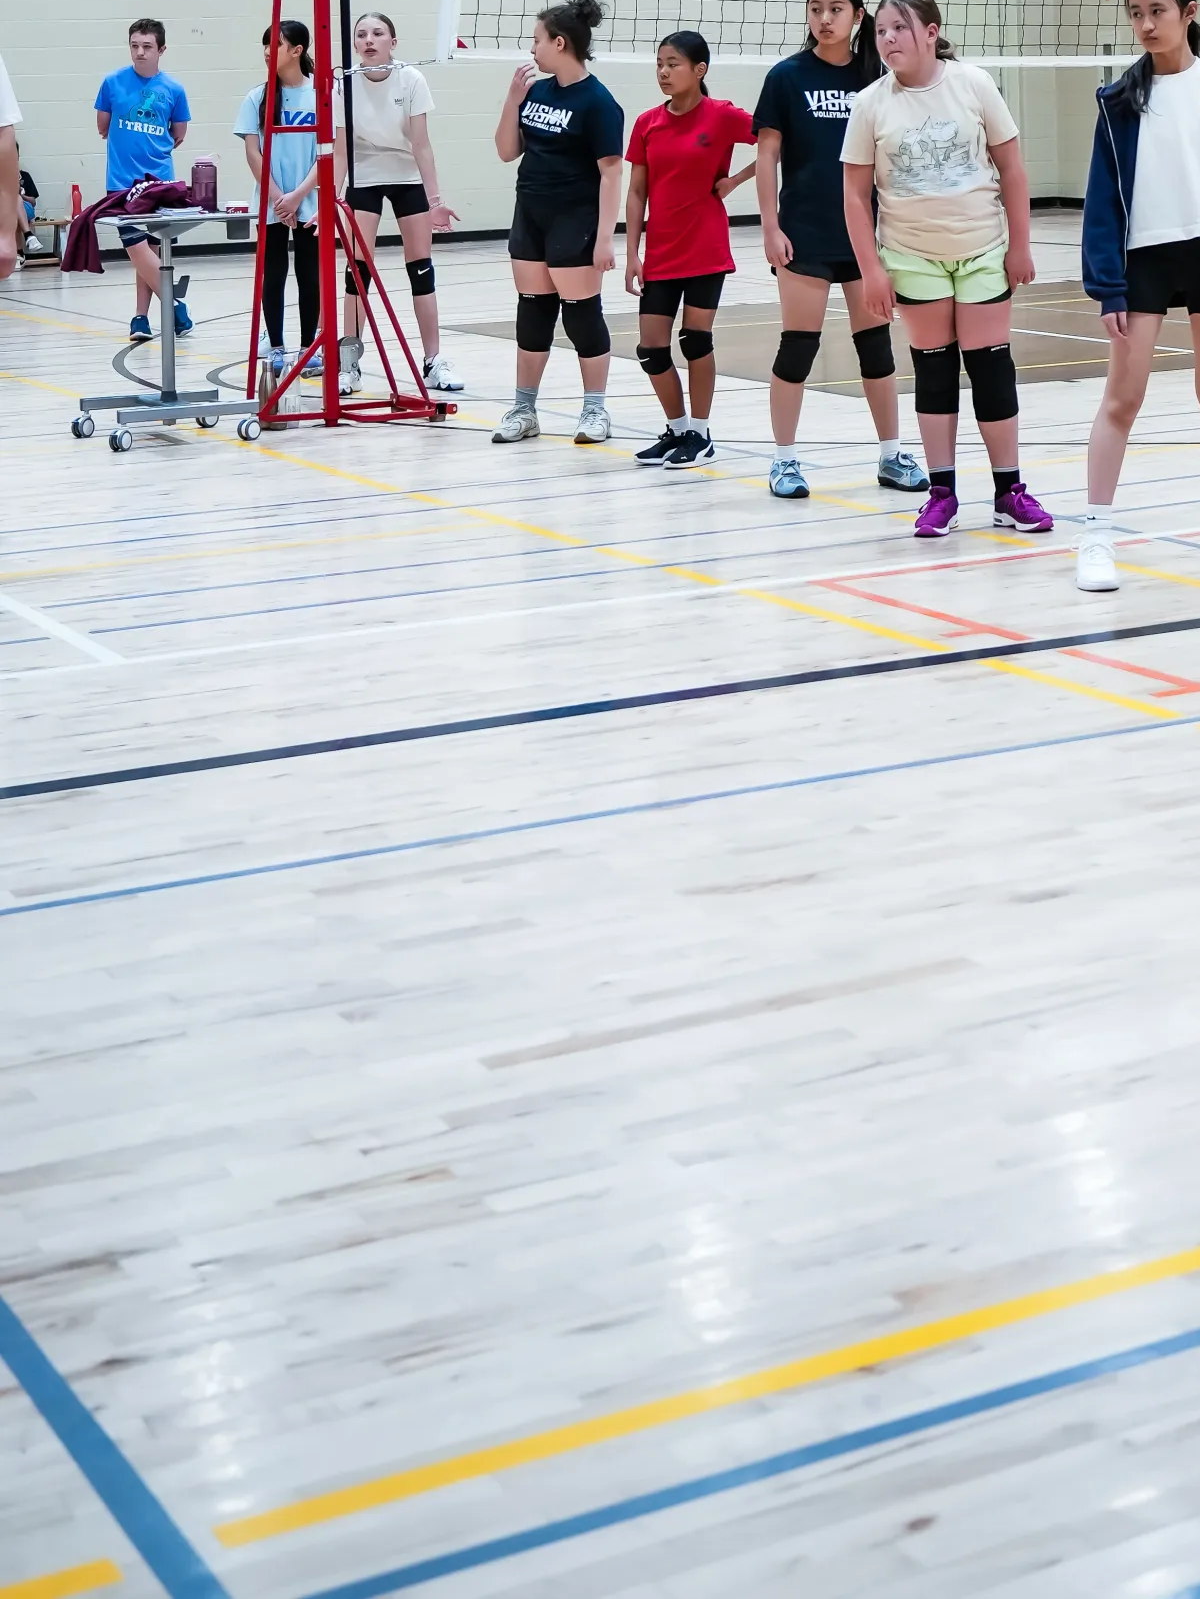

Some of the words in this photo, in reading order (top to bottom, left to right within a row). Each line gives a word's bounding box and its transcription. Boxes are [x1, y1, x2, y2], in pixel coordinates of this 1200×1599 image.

[521, 101, 573, 129] VISION
[119, 118, 123, 128] I
[126, 121, 164, 136] TRIED
